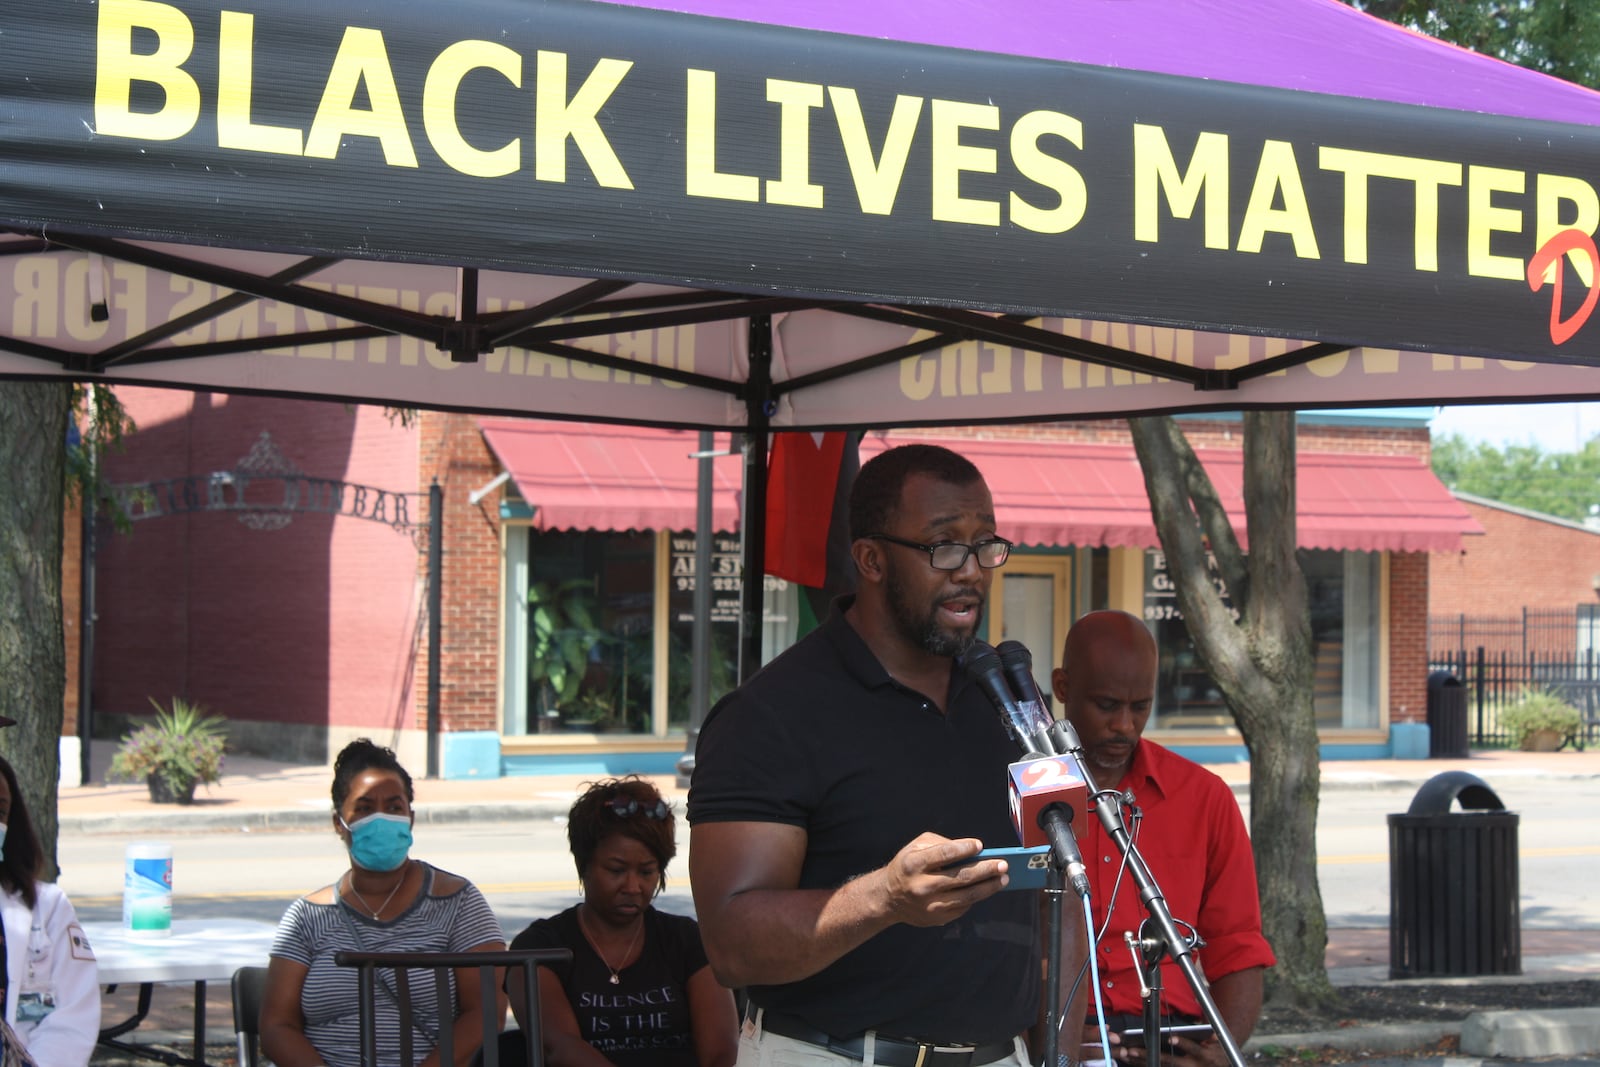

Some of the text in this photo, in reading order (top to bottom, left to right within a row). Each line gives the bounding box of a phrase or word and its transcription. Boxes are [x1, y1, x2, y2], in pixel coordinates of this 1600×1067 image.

[94, 1, 1600, 289] BLACK LIVES MATTER
[579, 986, 676, 1008] SILENCE
[592, 1011, 670, 1032] IS THE
